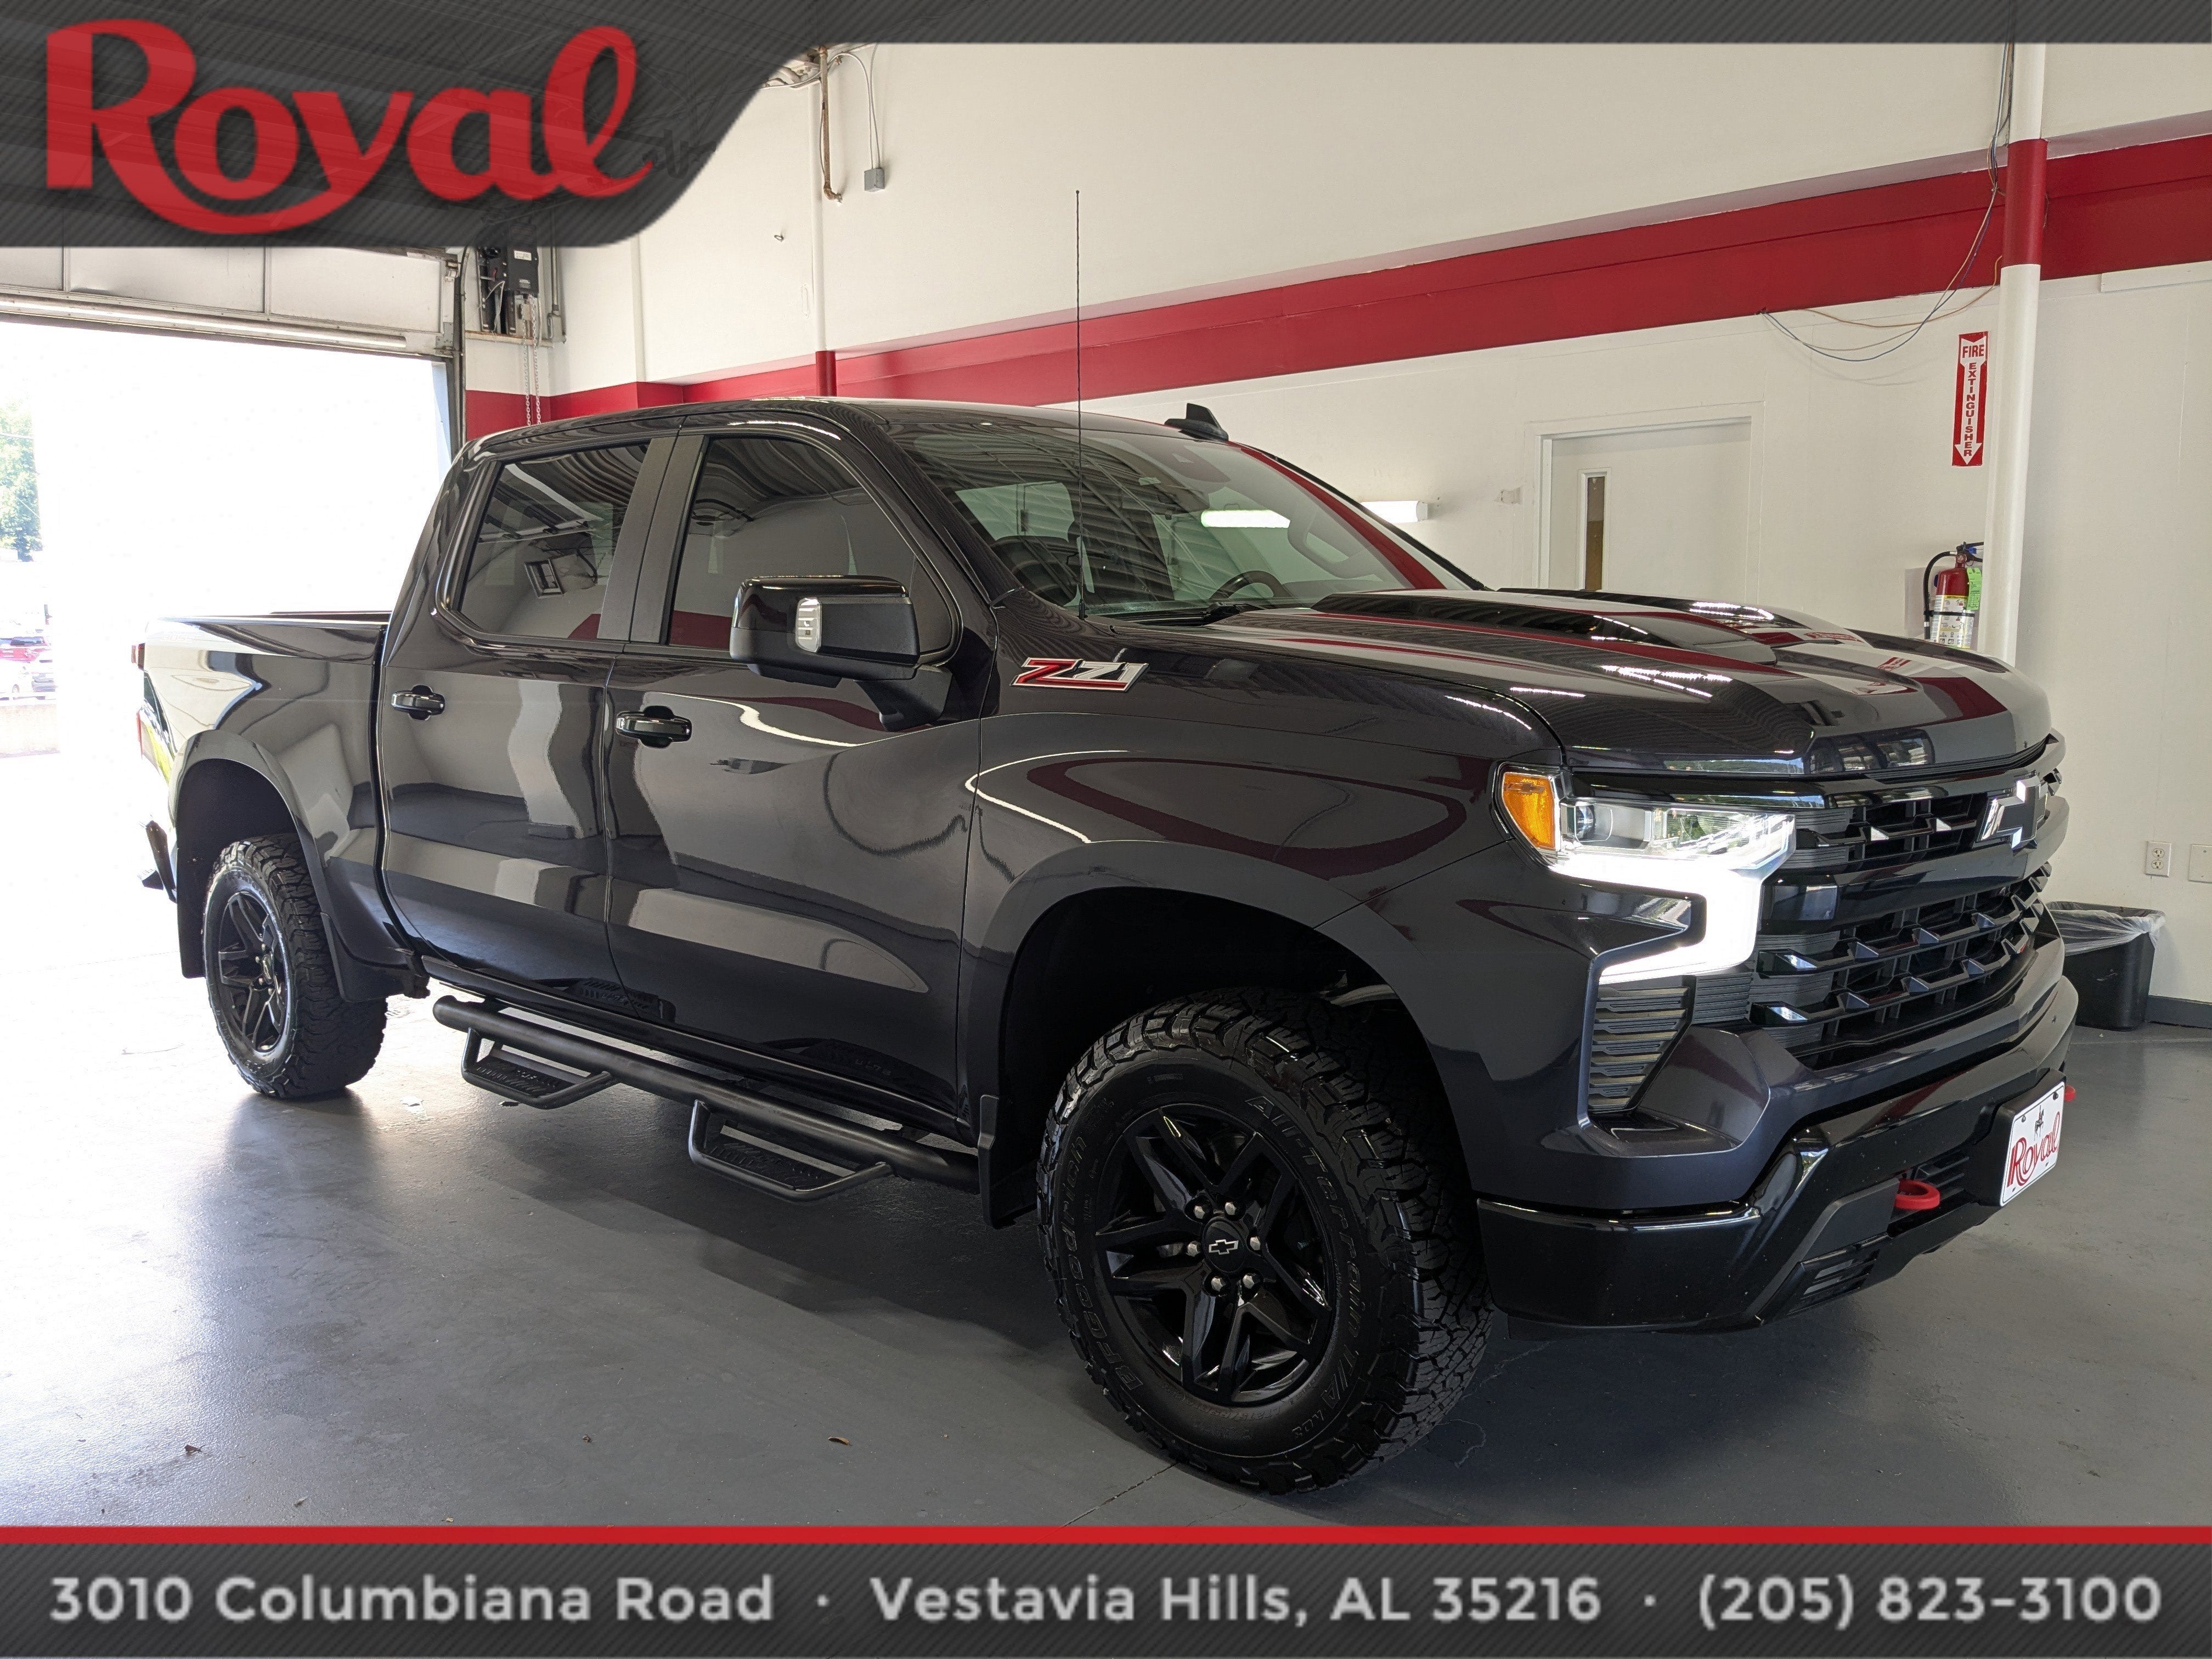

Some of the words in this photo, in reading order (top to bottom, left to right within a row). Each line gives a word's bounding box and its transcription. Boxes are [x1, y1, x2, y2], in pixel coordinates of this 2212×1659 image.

[1962, 344, 1984, 358] FIRE
[1963, 362, 1977, 456] EXTINGUISHER
[1010, 657, 1150, 692] Z71
[2006, 1111, 2061, 1187] Royal
